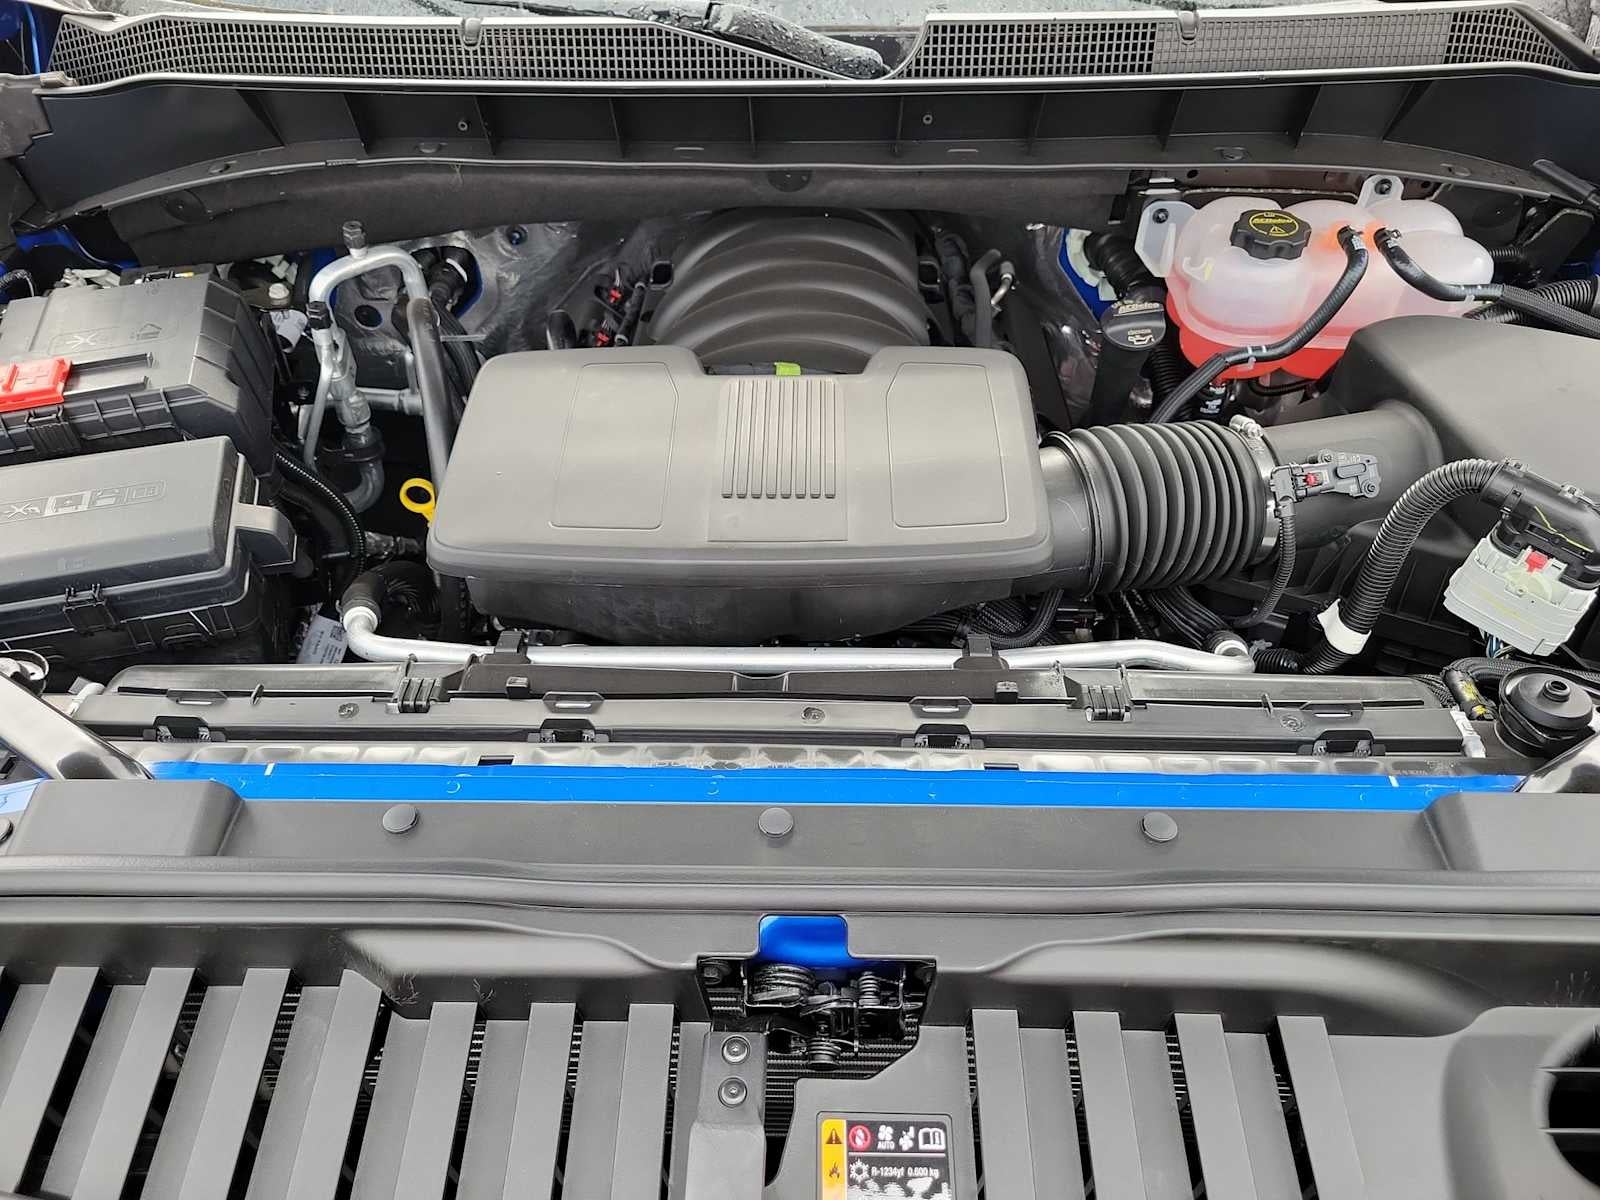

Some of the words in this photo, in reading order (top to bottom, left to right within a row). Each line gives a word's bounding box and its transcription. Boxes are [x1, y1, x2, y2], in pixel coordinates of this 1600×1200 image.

[877, 1140, 895, 1150] AUTO
[871, 1166, 904, 1178] R-1234yf
[929, 1167, 939, 1179] kg
